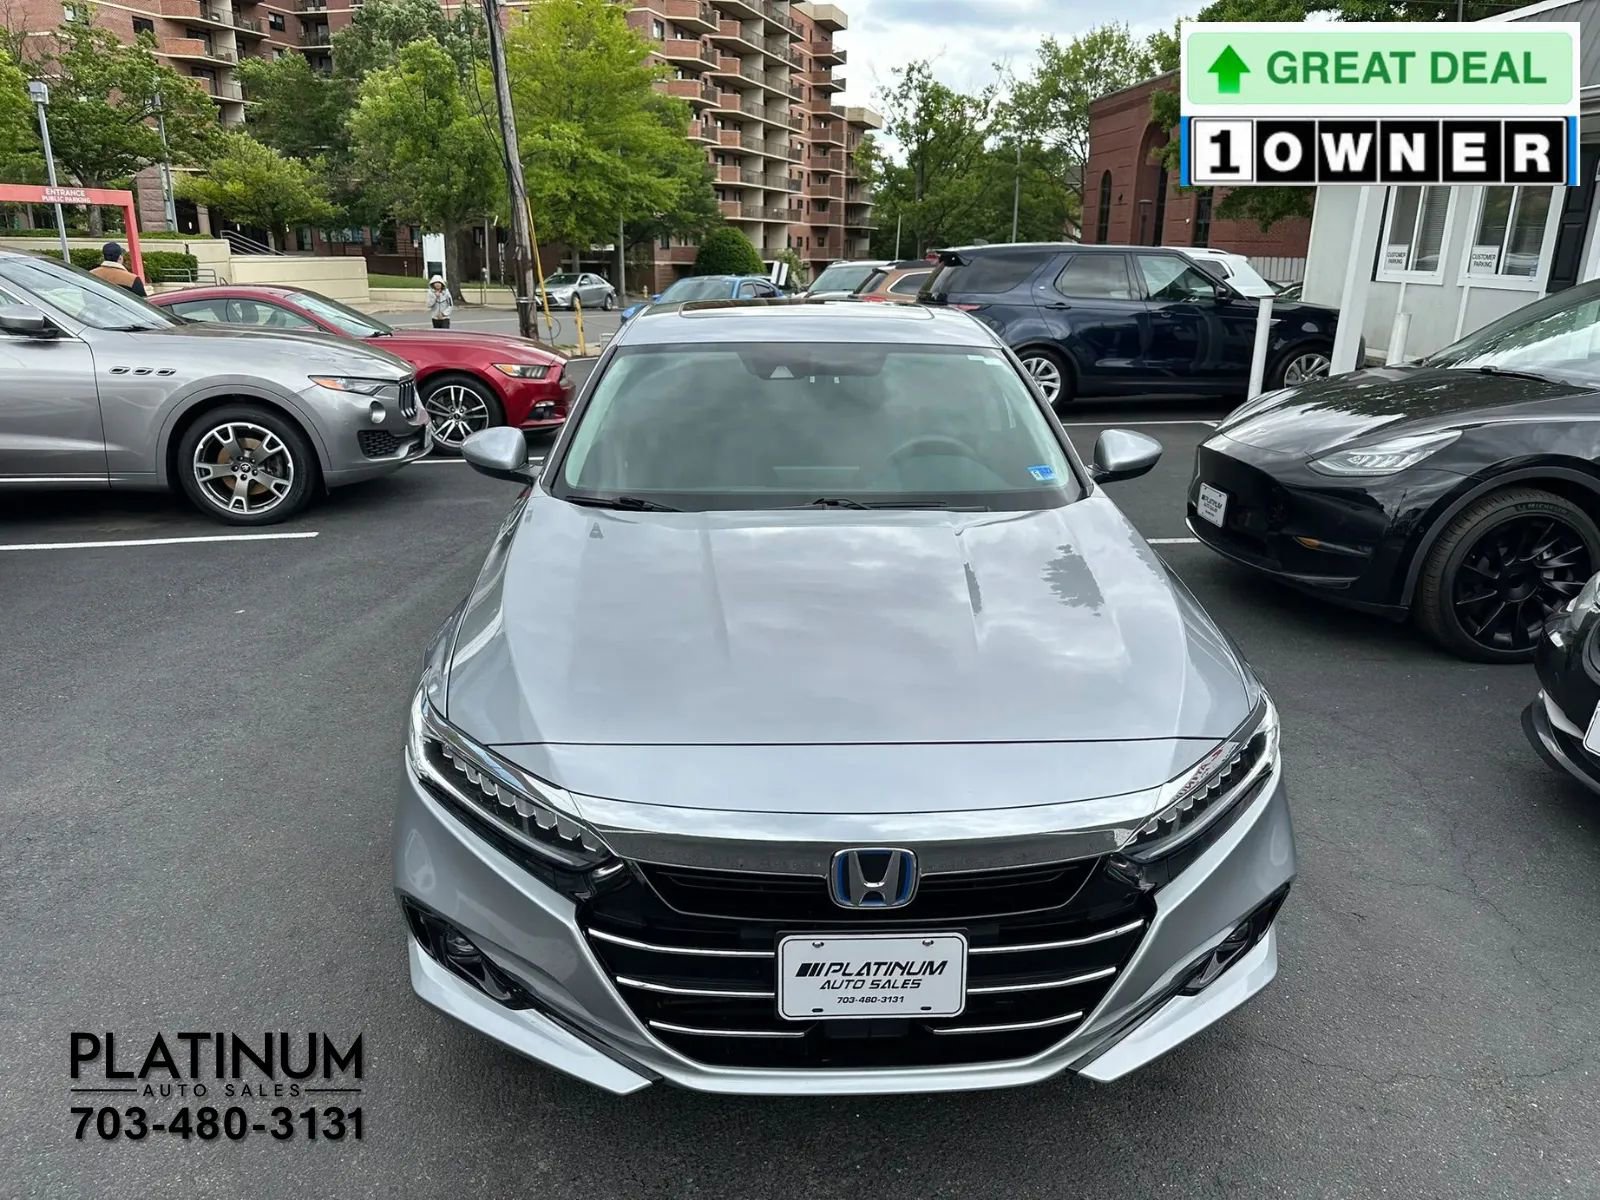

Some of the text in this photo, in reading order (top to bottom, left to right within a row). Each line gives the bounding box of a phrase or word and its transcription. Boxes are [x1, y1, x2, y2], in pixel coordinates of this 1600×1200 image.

[45, 187, 86, 197] ENTRANCE
[65, 196, 92, 204] PARKING
[1472, 253, 1496, 261] CUSTOMER
[824, 960, 949, 977] PLATINUM
[819, 978, 923, 990] AUTO SALES
[837, 996, 905, 1004] 703-480-3131
